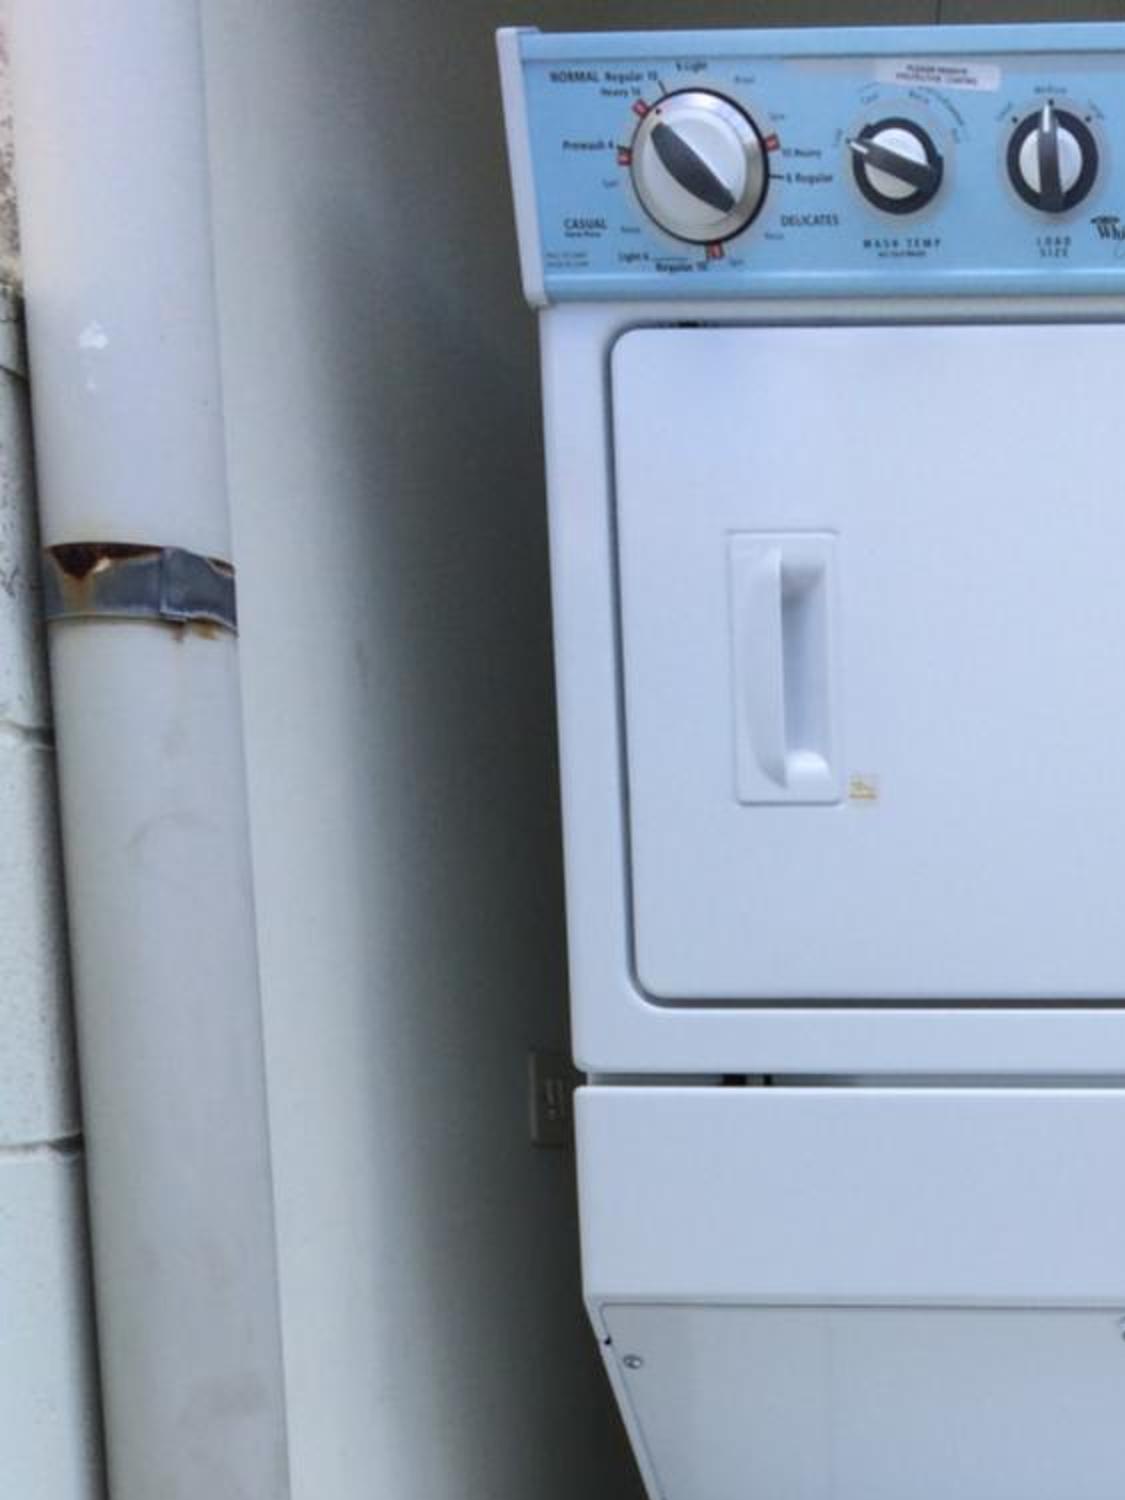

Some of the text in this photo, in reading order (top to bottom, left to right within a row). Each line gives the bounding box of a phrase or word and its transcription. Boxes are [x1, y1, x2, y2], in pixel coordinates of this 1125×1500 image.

[549, 71, 600, 83] NORMAL
[604, 71, 643, 84] Regular
[796, 173, 833, 186] Regular
[563, 217, 608, 230] CASUAL
[781, 214, 839, 227] DELICATES
[863, 237, 941, 249] WASH TEMP
[655, 262, 693, 275] Regular
